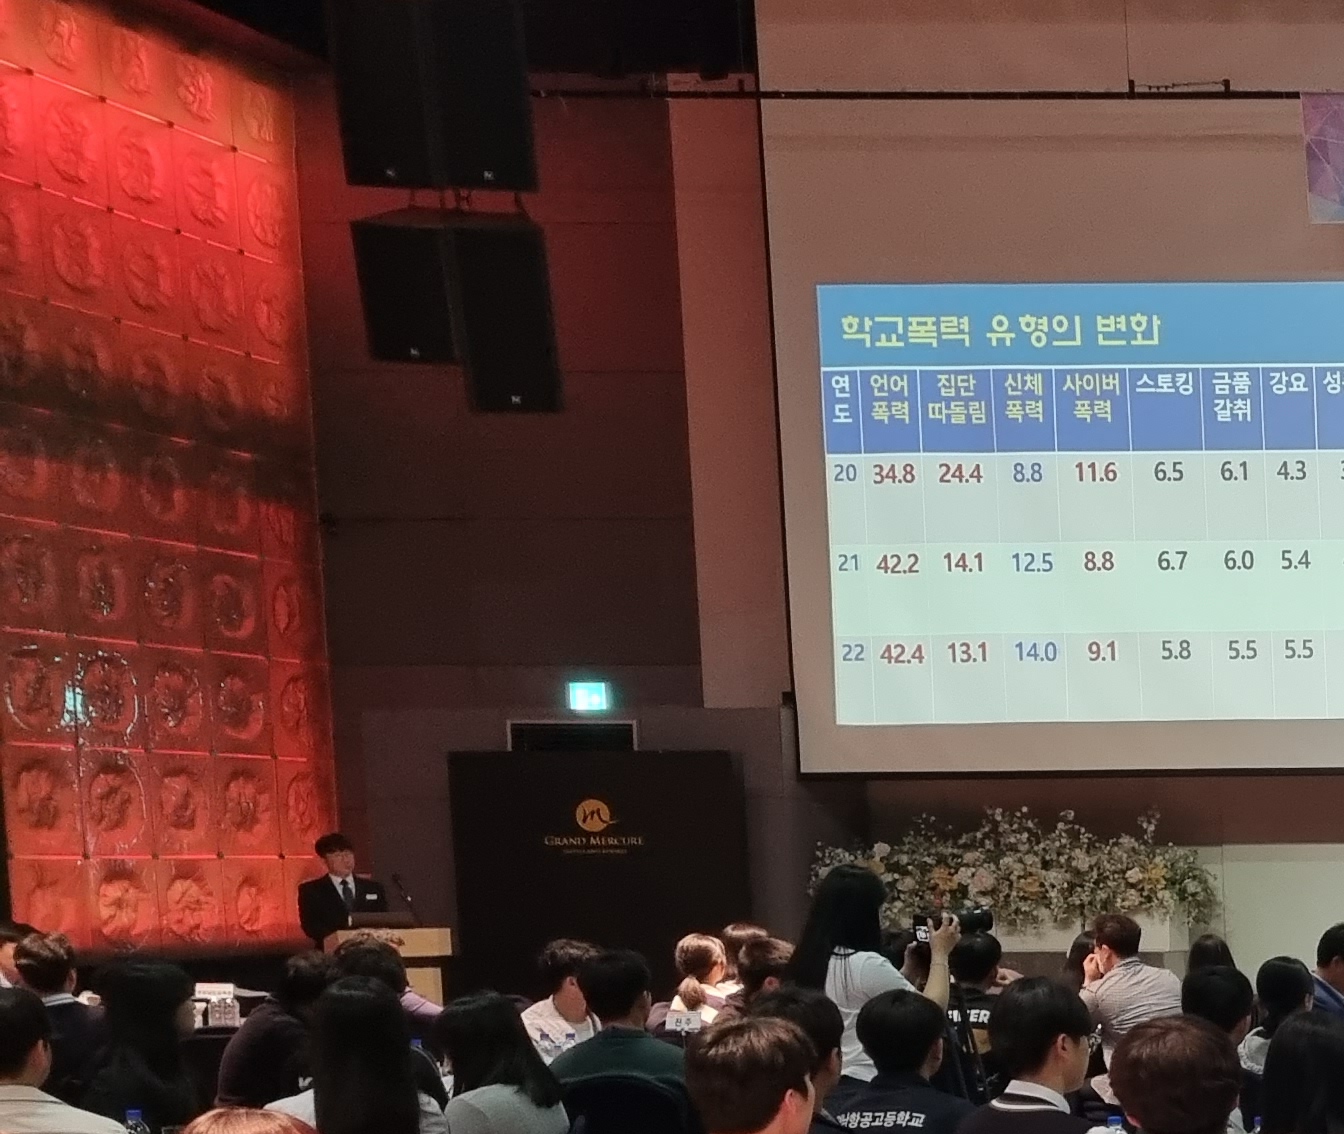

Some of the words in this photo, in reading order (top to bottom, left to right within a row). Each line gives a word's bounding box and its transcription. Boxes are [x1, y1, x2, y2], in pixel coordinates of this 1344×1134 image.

[842, 316, 969, 347] 학교폭력
[987, 314, 1081, 347] 유형의
[1097, 313, 1160, 345] 변화
[871, 374, 908, 396] 언어
[937, 374, 976, 396] 집단
[1005, 373, 1042, 396] 신체
[1063, 373, 1119, 396] 사이버
[1136, 372, 1193, 395] 스토킹
[1212, 372, 1251, 394] 금품
[1270, 371, 1308, 394] 강요
[872, 401, 909, 424] 폭력
[928, 401, 985, 424] 따돌림
[1005, 400, 1042, 423] 폭력
[1074, 400, 1111, 422] 폭력
[1214, 399, 1250, 421] 갈취
[834, 464, 856, 481] 20
[874, 464, 915, 484] 34.8
[939, 463, 983, 483] 24.4
[1014, 463, 1042, 482] 8.8
[1076, 462, 1117, 482] 11.6
[1154, 462, 1183, 481] 6.5
[1221, 461, 1247, 481] 6.1
[1277, 461, 1306, 480] 4.3
[839, 554, 858, 571] 21
[877, 554, 919, 574] 42.2
[944, 553, 982, 572] 14.1
[1012, 553, 1053, 572] 12.5
[1084, 551, 1114, 571] 8.8
[1158, 551, 1187, 570] 6.7
[1224, 550, 1254, 570] 6.0
[1282, 550, 1311, 569] 5.4
[843, 644, 864, 661] 22
[880, 644, 924, 664] 42.4
[948, 642, 986, 663] 13.1
[1015, 642, 1057, 661] 14.0
[1088, 641, 1115, 661] 9.1
[1162, 640, 1191, 660] 5.8
[1229, 640, 1257, 659] 5.5
[1285, 640, 1313, 659] 5.5
[544, 835, 587, 846] GRAND
[590, 835, 644, 846] MERCURE
